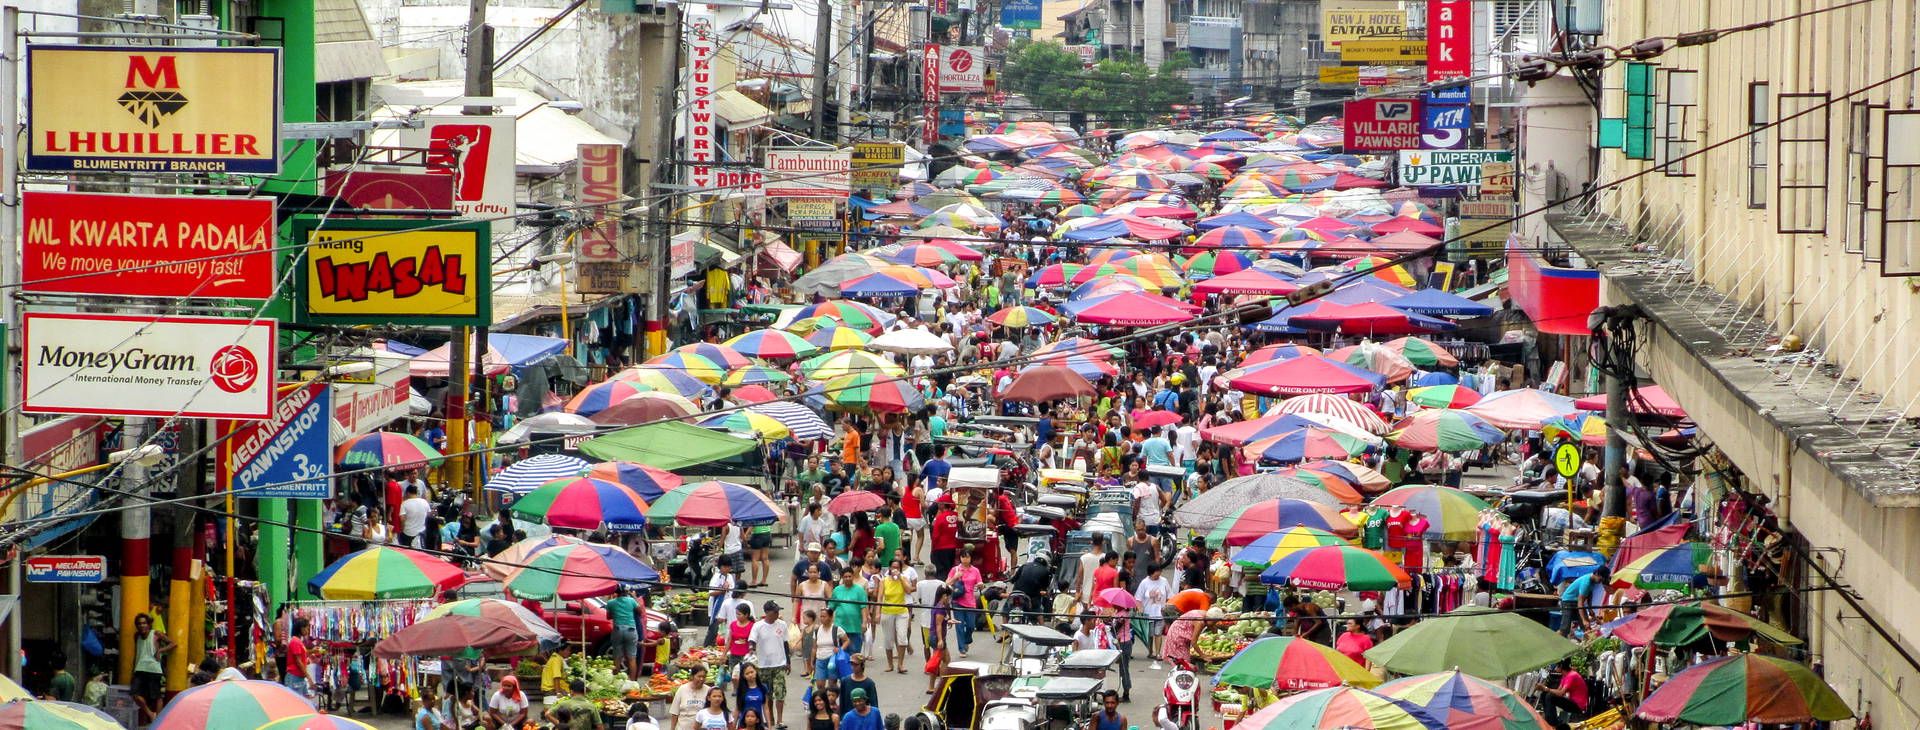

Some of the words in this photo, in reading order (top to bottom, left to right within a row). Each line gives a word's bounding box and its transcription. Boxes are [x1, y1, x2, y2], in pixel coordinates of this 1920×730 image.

[1330, 14, 1354, 24] NEW
[1356, 14, 1365, 24] J.
[1369, 14, 1401, 24] HOTEL
[1330, 26, 1401, 34] ENTRANCE
[1440, 0, 1456, 61] ank
[125, 55, 180, 89] M
[943, 73, 980, 81] HORTALEZA
[1379, 104, 1409, 118] VP
[1433, 107, 1464, 128] ATM
[46, 130, 261, 156] LHUILLIER
[73, 159, 167, 170] BLUMENTRITT
[170, 161, 226, 172] BRANCH
[767, 153, 849, 175] Tambunting
[717, 172, 762, 189] DRUG
[27, 218, 61, 246] ML
[69, 219, 169, 248] KWARTA
[178, 221, 268, 251] PADALA
[318, 236, 363, 253] Mang
[42, 251, 67, 271] We
[70, 255, 112, 272] move
[116, 257, 151, 277] your
[154, 259, 205, 280] money
[210, 257, 244, 275] fast!
[315, 245, 467, 302] INASAL
[38, 345, 196, 373] MoneyGram
[75, 373, 134, 384] International
[135, 375, 164, 386] Money
[166, 377, 203, 387] Transfer
[224, 389, 311, 475] MEGATREND
[239, 403, 320, 490] PAWNSHOP
[292, 453, 325, 482] 3%
[265, 482, 327, 491] BLUMENTRITT
[55, 561, 101, 569] MEGATREND
[1301, 579, 1341, 589] MICROMATIC
